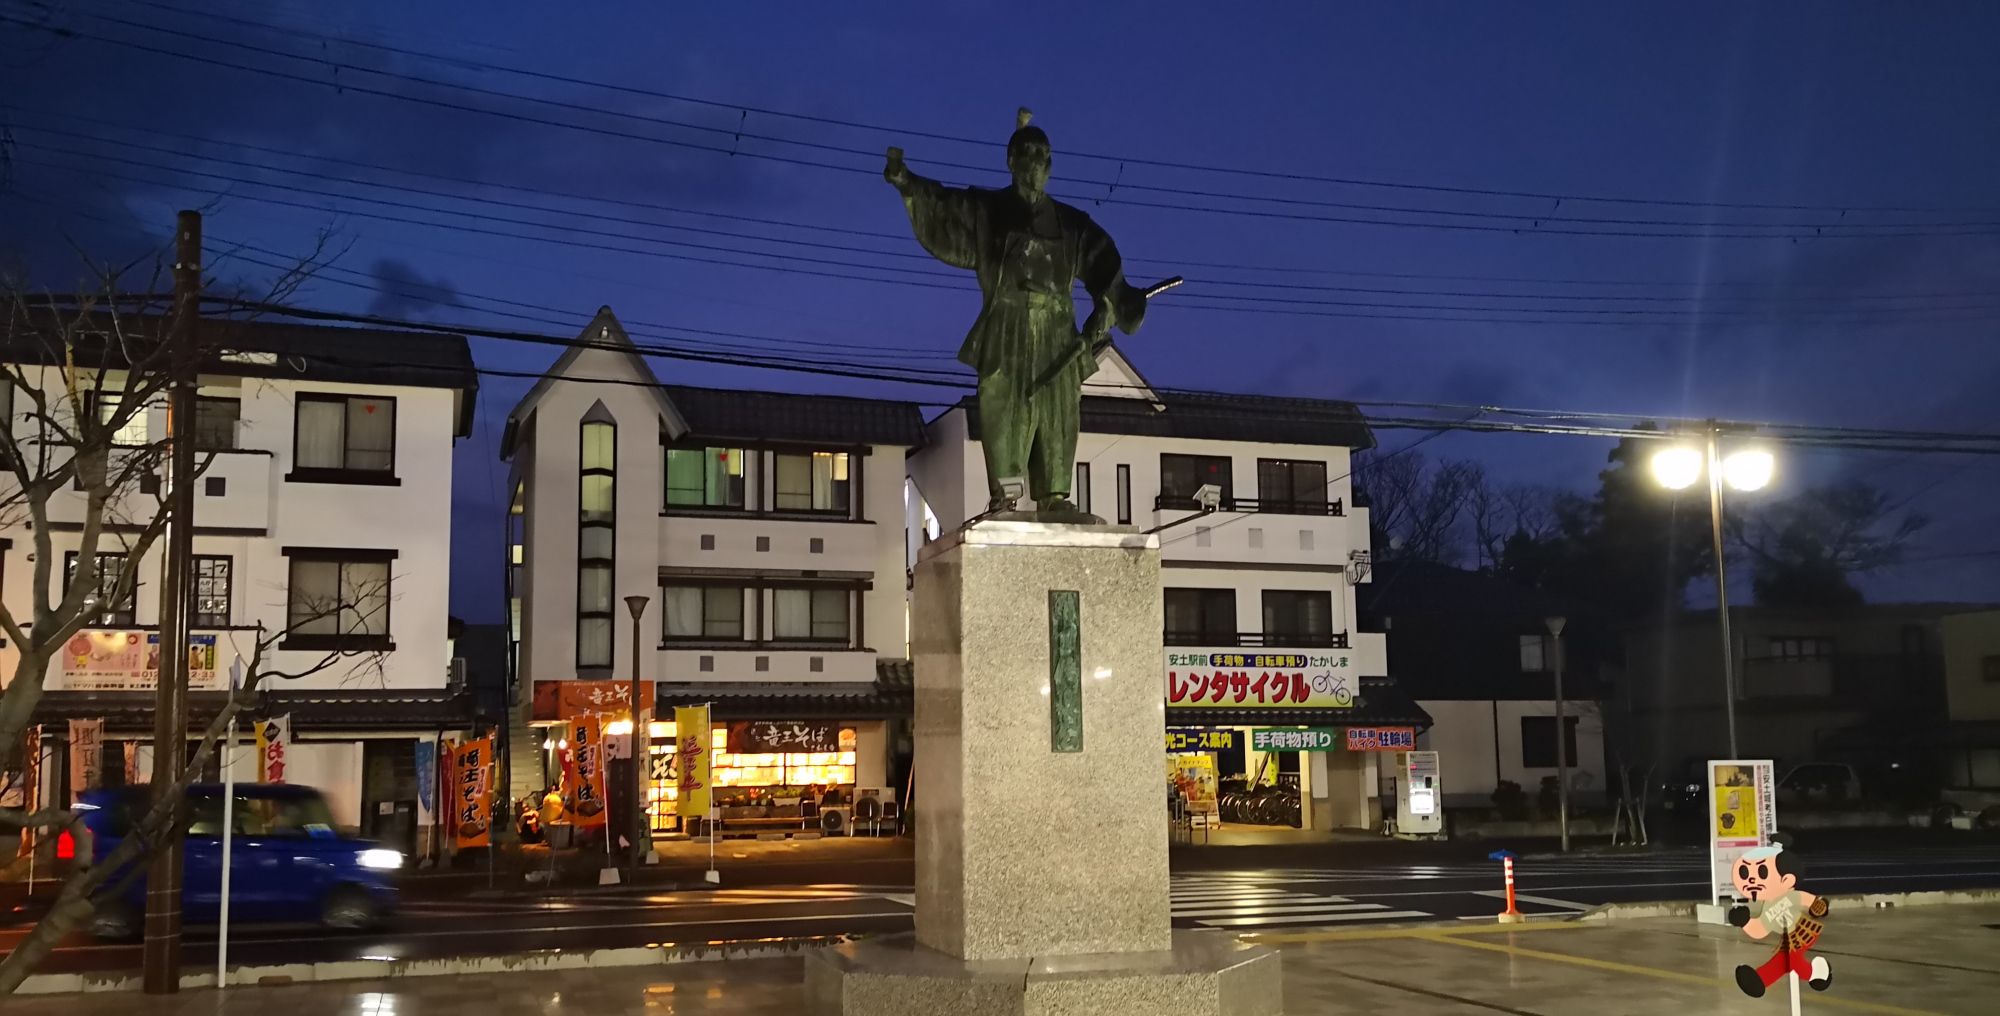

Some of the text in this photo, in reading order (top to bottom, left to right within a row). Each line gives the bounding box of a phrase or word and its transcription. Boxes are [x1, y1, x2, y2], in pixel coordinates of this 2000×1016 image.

[1169, 654, 1349, 668] 安土駅前 手荷物・自転車預り たかしま
[1169, 670, 1310, 704] レンタサイクル
[1254, 731, 1332, 748] 手荷物預り
[1348, 728, 1376, 738] 自転車
[1378, 731, 1412, 747] 駐輪場
[1348, 738, 1376, 749] バイク
[267, 740, 286, 784] お食
